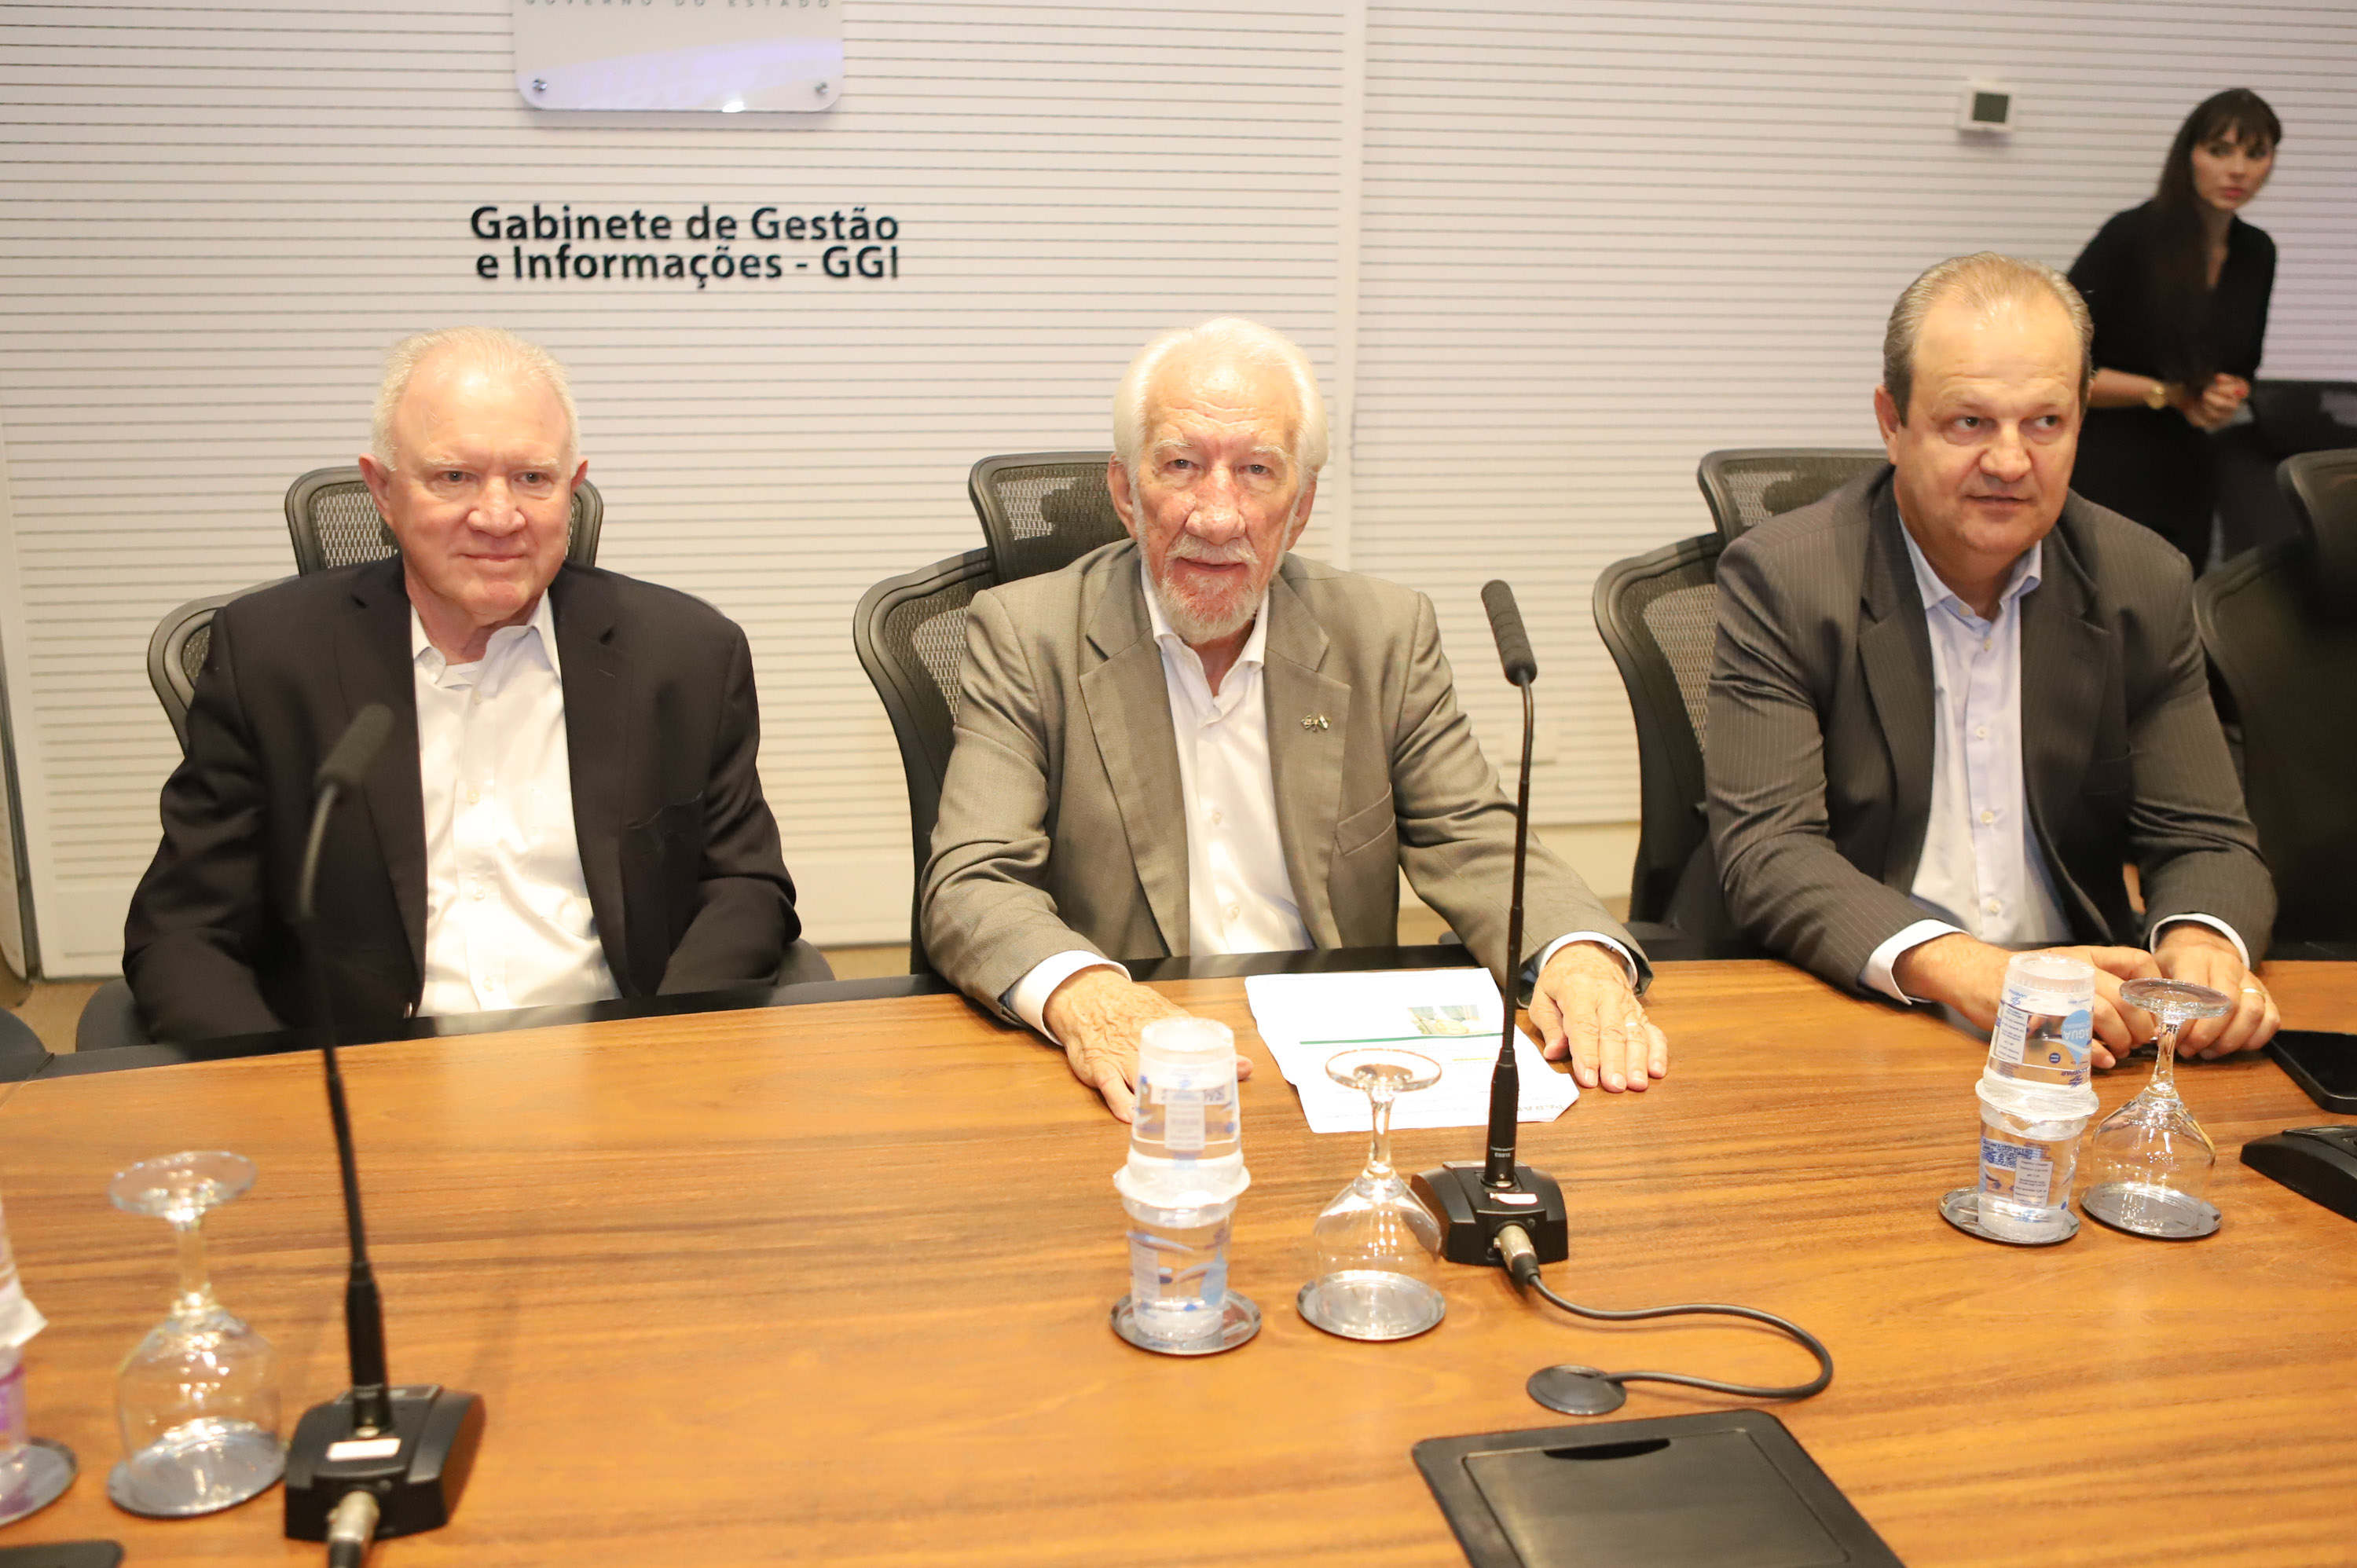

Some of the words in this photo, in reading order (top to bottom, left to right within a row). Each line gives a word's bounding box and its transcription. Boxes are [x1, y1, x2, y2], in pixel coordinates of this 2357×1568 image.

[471, 203, 672, 240] Gabinete
[686, 204, 737, 240] de
[751, 207, 899, 240] Gestão
[476, 254, 499, 279] e
[513, 244, 783, 289] Informações
[822, 245, 897, 278] GGI
